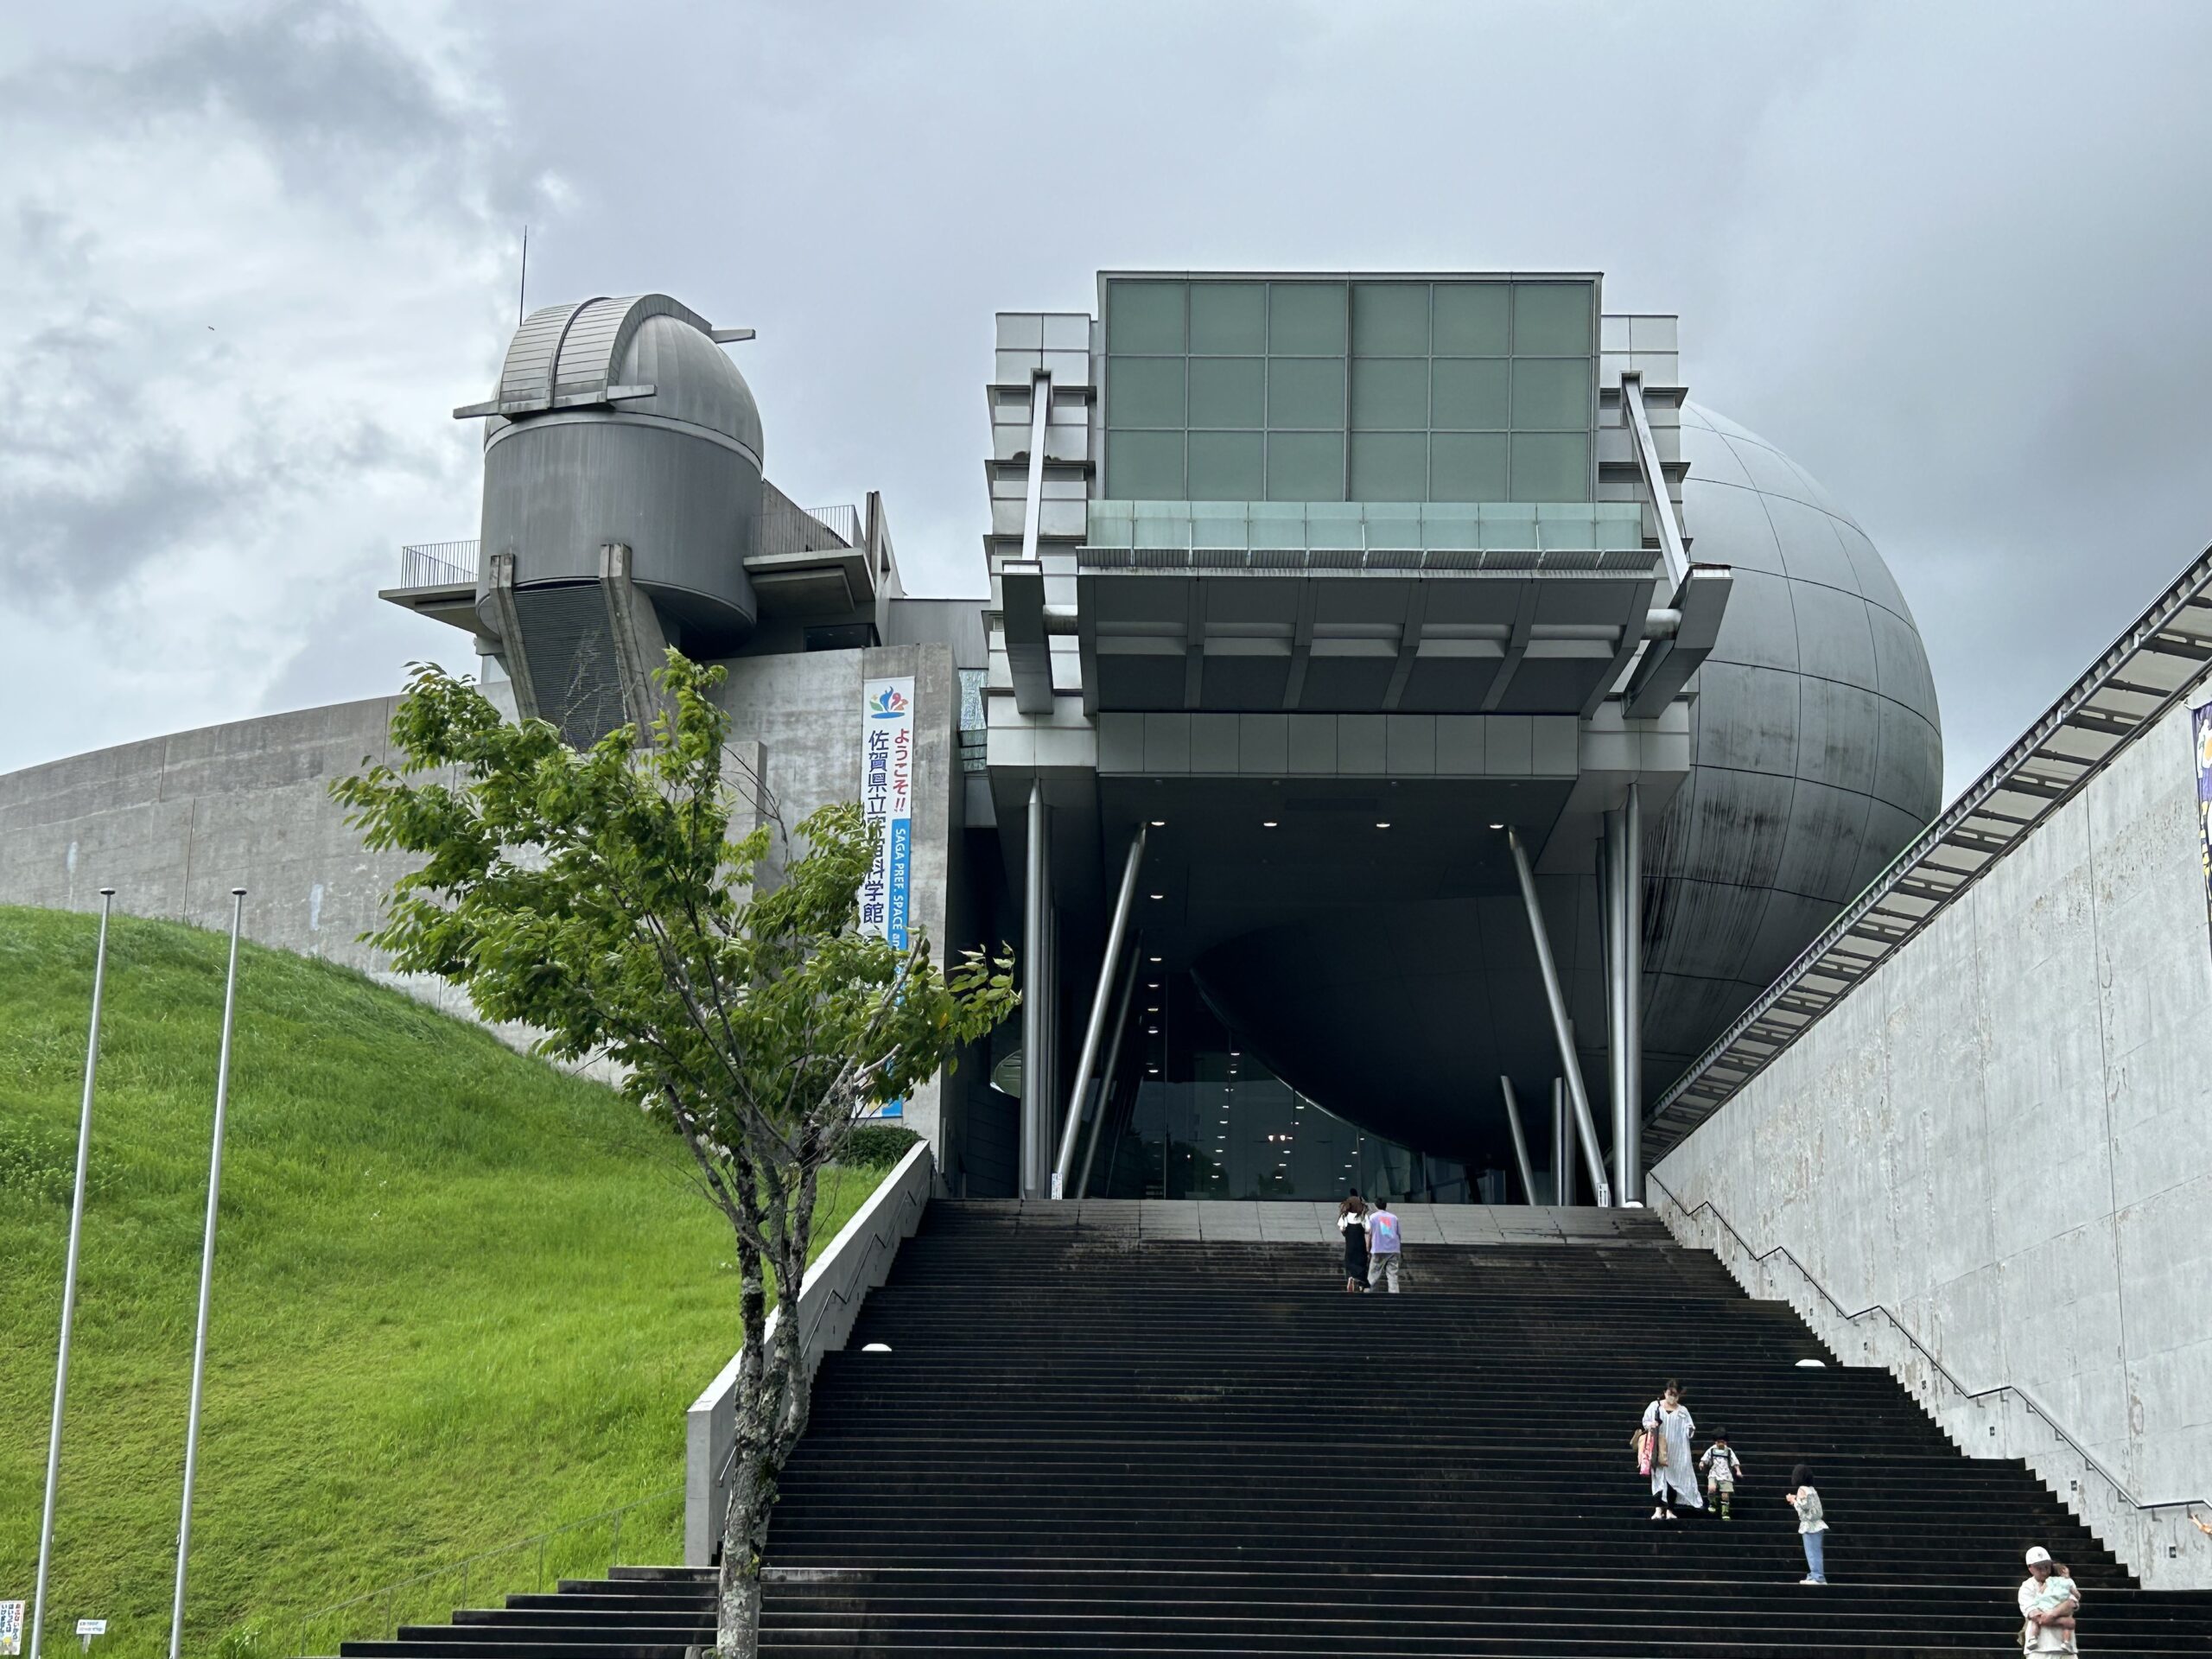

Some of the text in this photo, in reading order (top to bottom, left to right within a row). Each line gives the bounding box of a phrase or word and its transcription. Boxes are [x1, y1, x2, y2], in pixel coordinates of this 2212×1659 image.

[895, 828, 906, 860] SAGA
[893, 863, 905, 893] PREF.
[893, 895, 904, 930] SPACE
